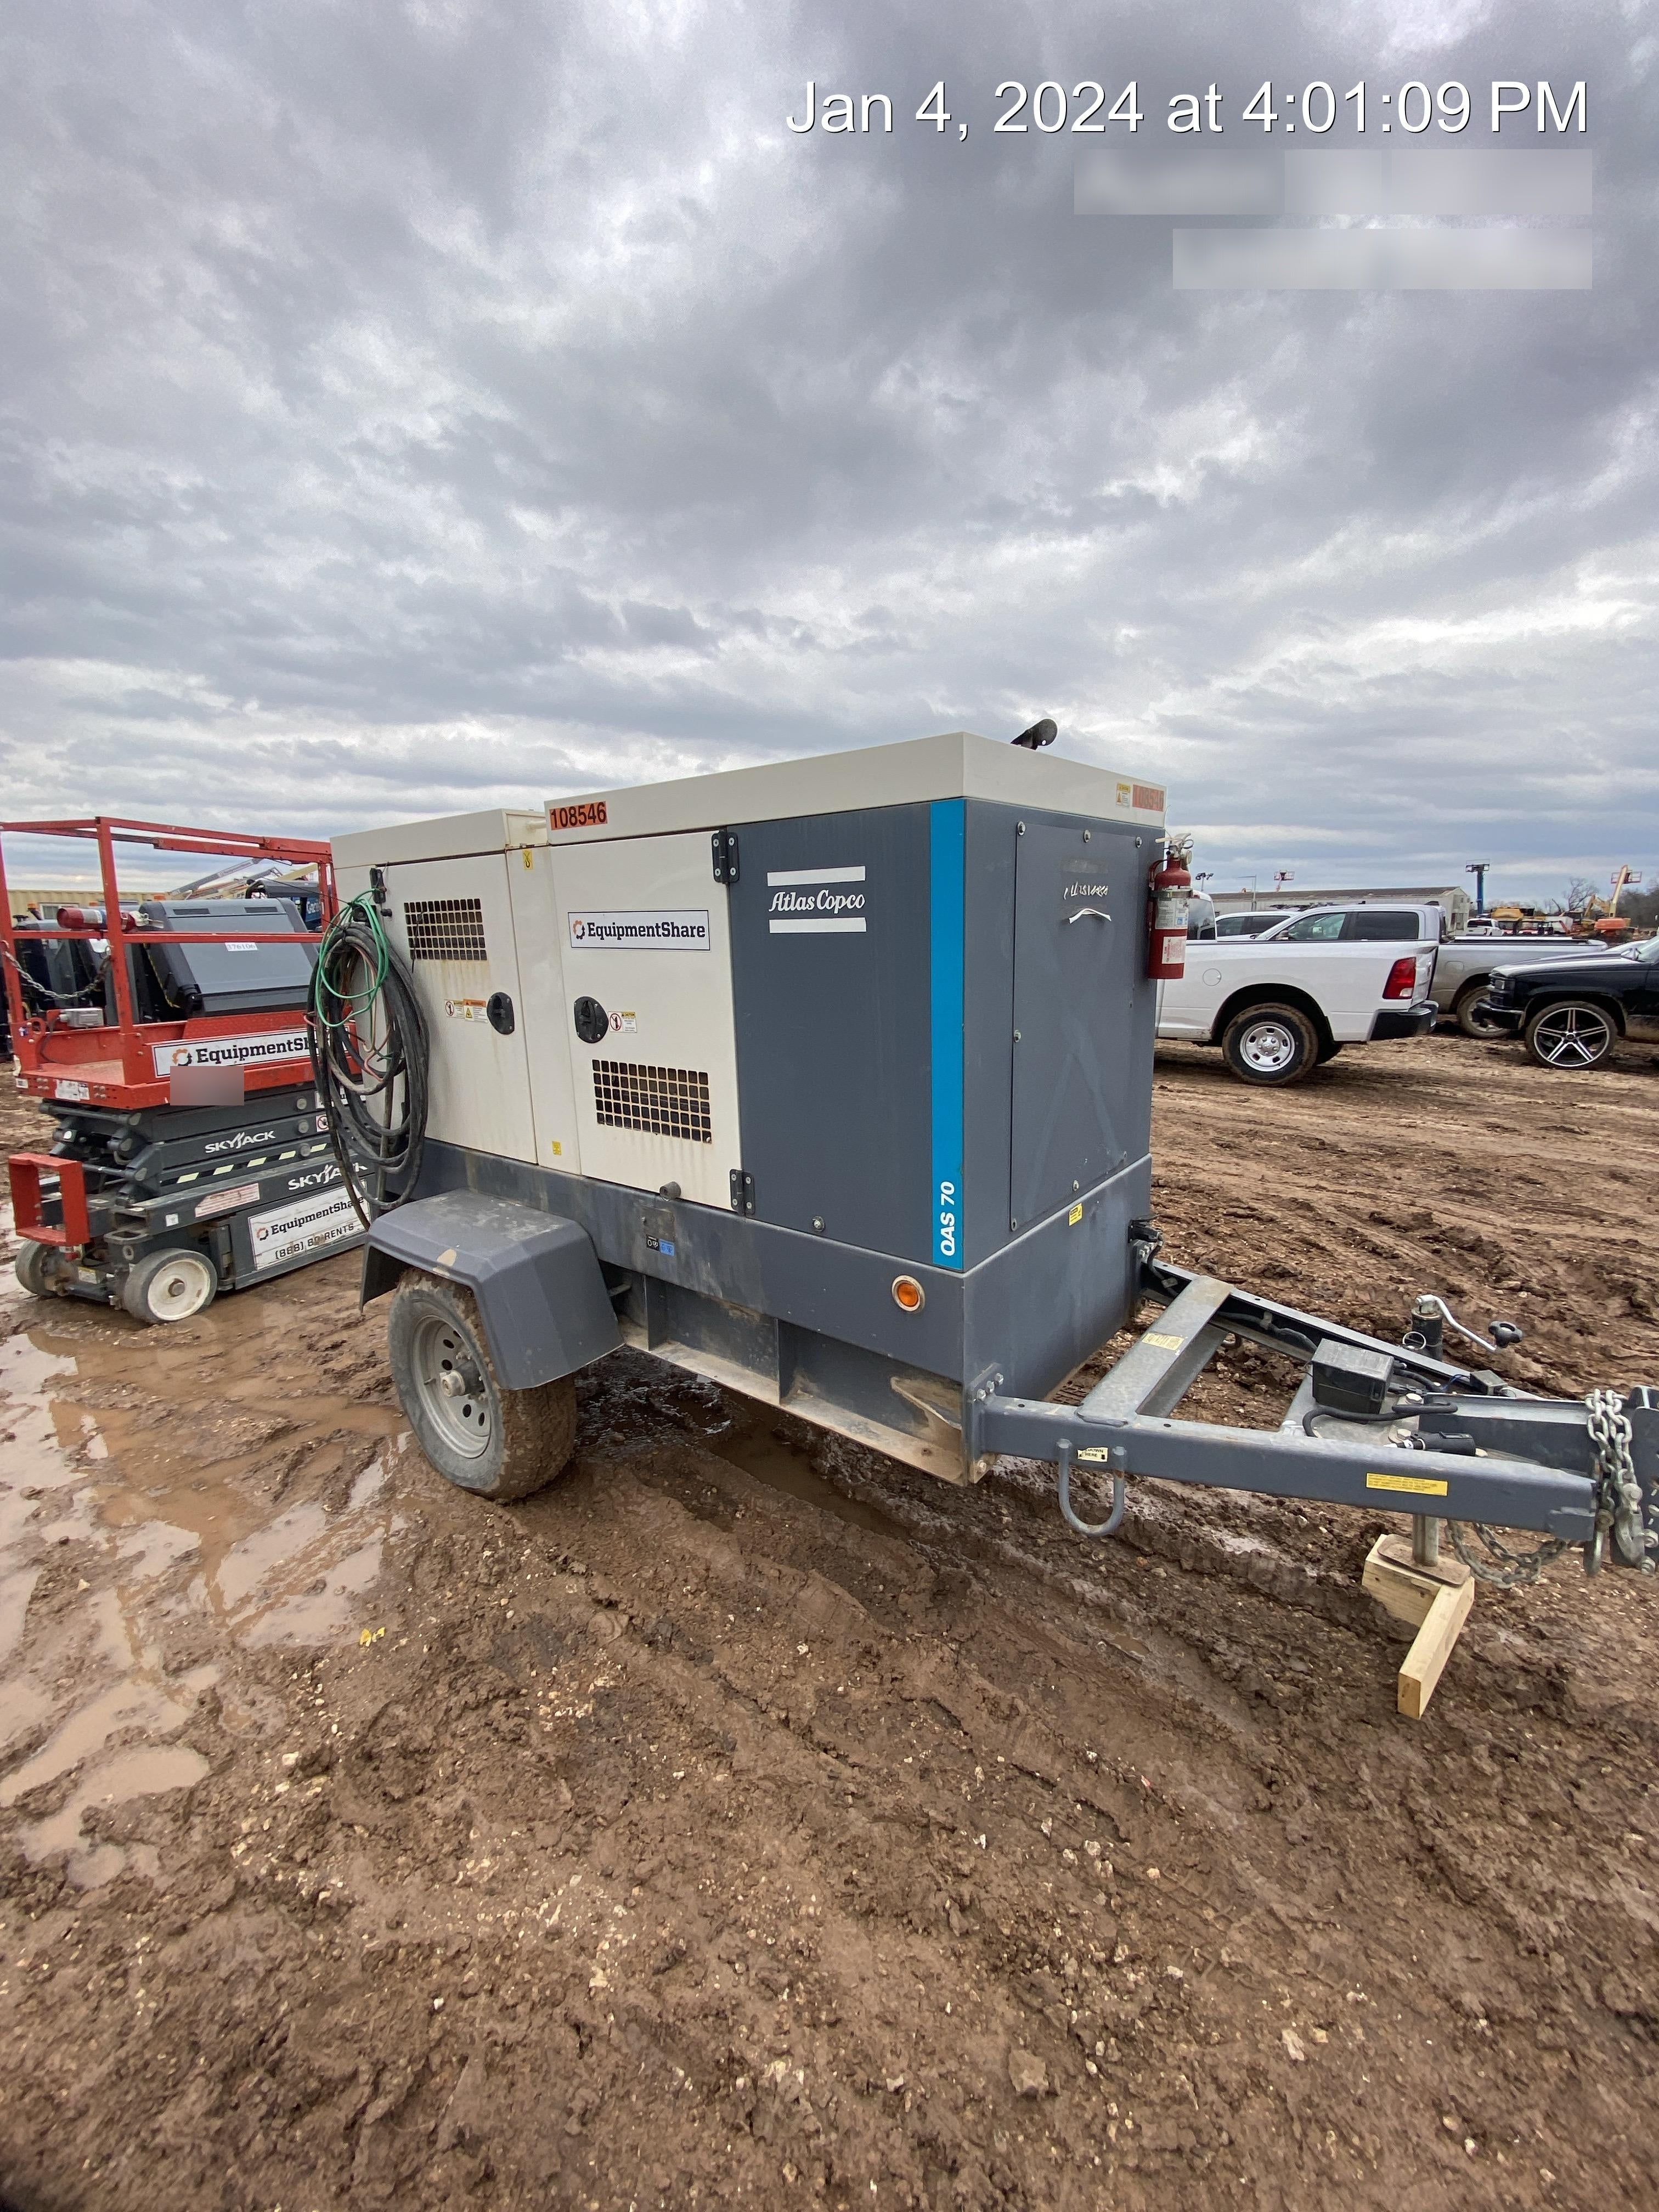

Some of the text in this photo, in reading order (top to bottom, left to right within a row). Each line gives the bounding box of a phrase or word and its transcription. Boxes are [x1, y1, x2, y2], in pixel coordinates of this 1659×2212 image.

[551, 802, 606, 828] 108546
[769, 889, 866, 914] Atlas Copco
[586, 922, 706, 940] EquipmentShare
[205, 1130, 276, 1153] SKYJACK
[288, 1162, 368, 1190] SKYJAK
[270, 1196, 364, 1235] EquipmentShae
[940, 1181, 955, 1256] QAS 70
